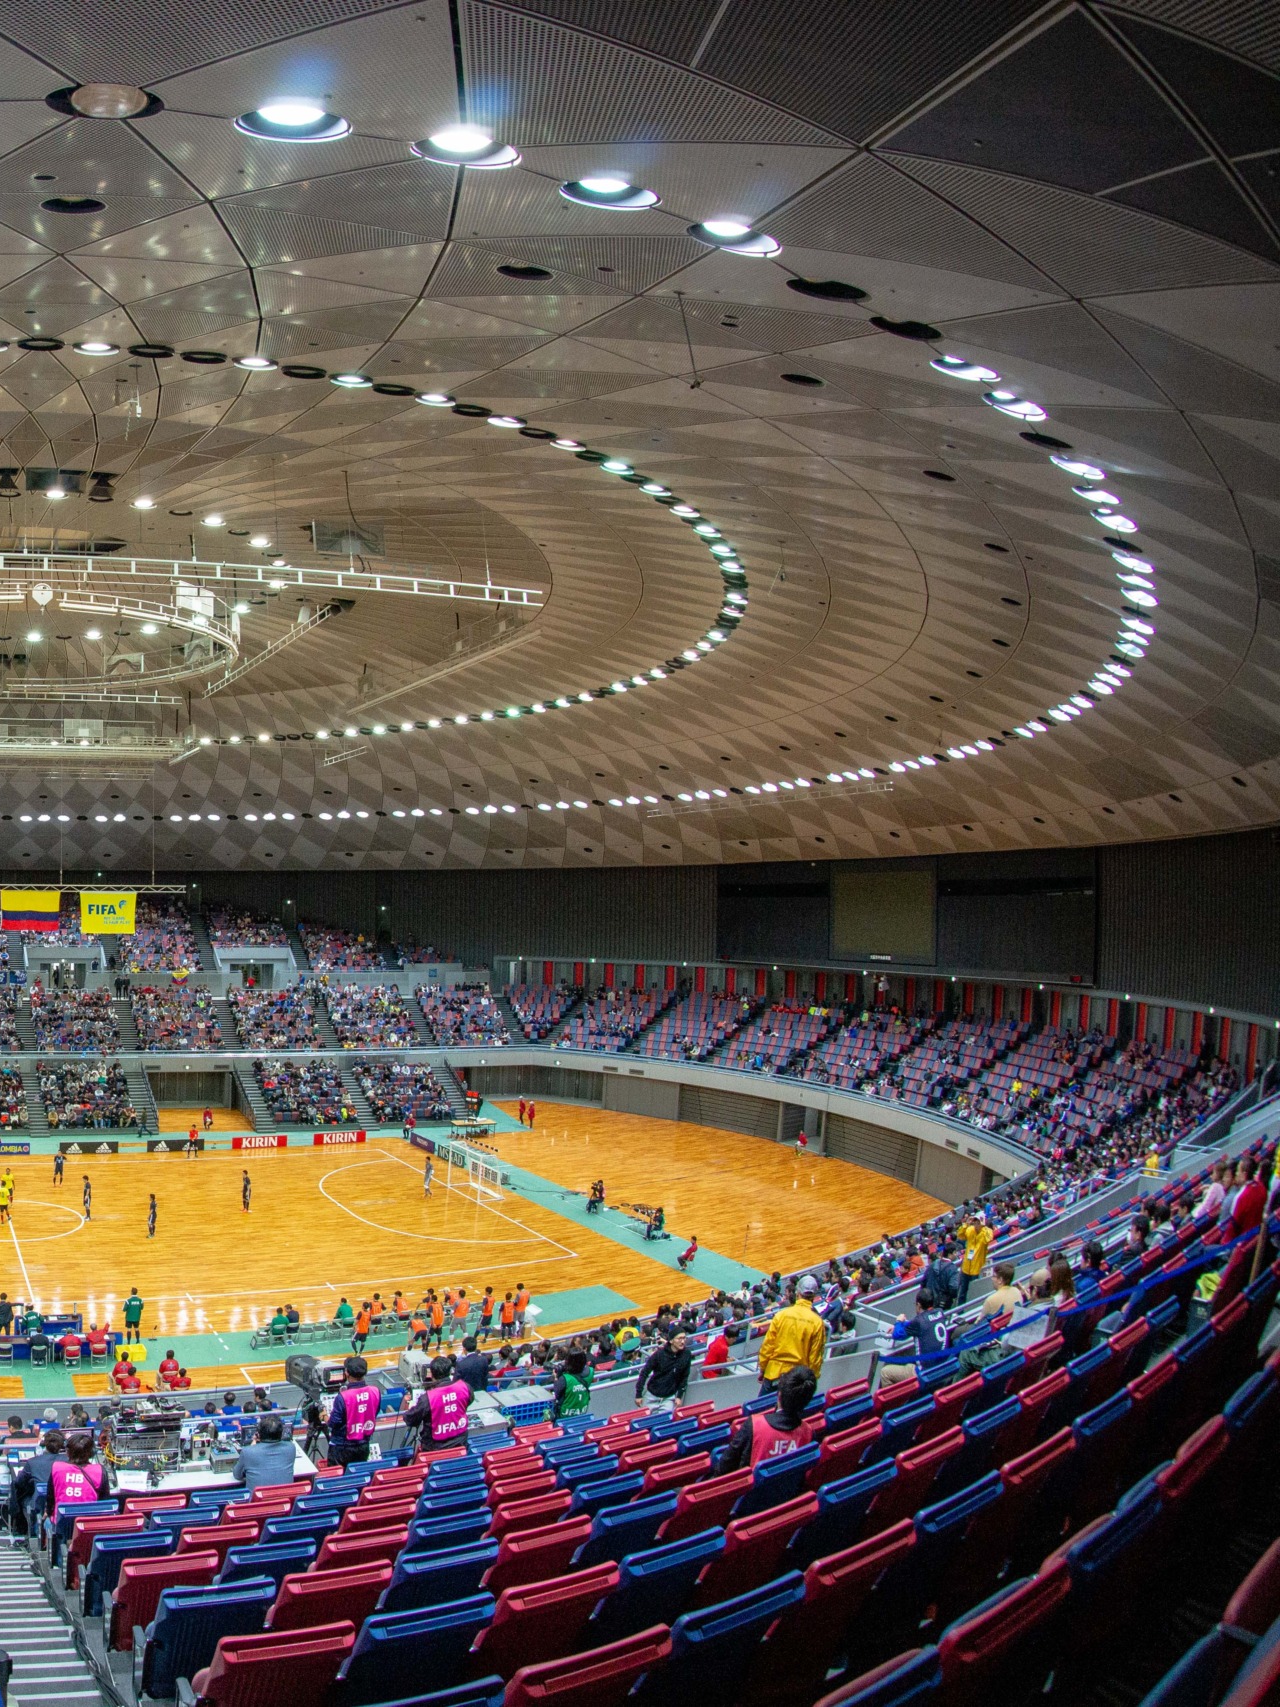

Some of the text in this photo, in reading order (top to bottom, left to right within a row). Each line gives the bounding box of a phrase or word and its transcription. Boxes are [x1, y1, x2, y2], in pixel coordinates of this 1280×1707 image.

[88, 904, 116, 915] FIFA
[241, 1136, 278, 1148] KIRIN
[323, 1132, 357, 1144] KIRIN
[934, 1323, 947, 1342] 9
[442, 1392, 457, 1403] HB
[444, 1404, 457, 1414] 56
[562, 1408, 580, 1416] JFA
[435, 1422, 457, 1435] JFA
[769, 1440, 797, 1455] JFA
[65, 1473, 84, 1484] HB
[65, 1487, 82, 1497] 65
